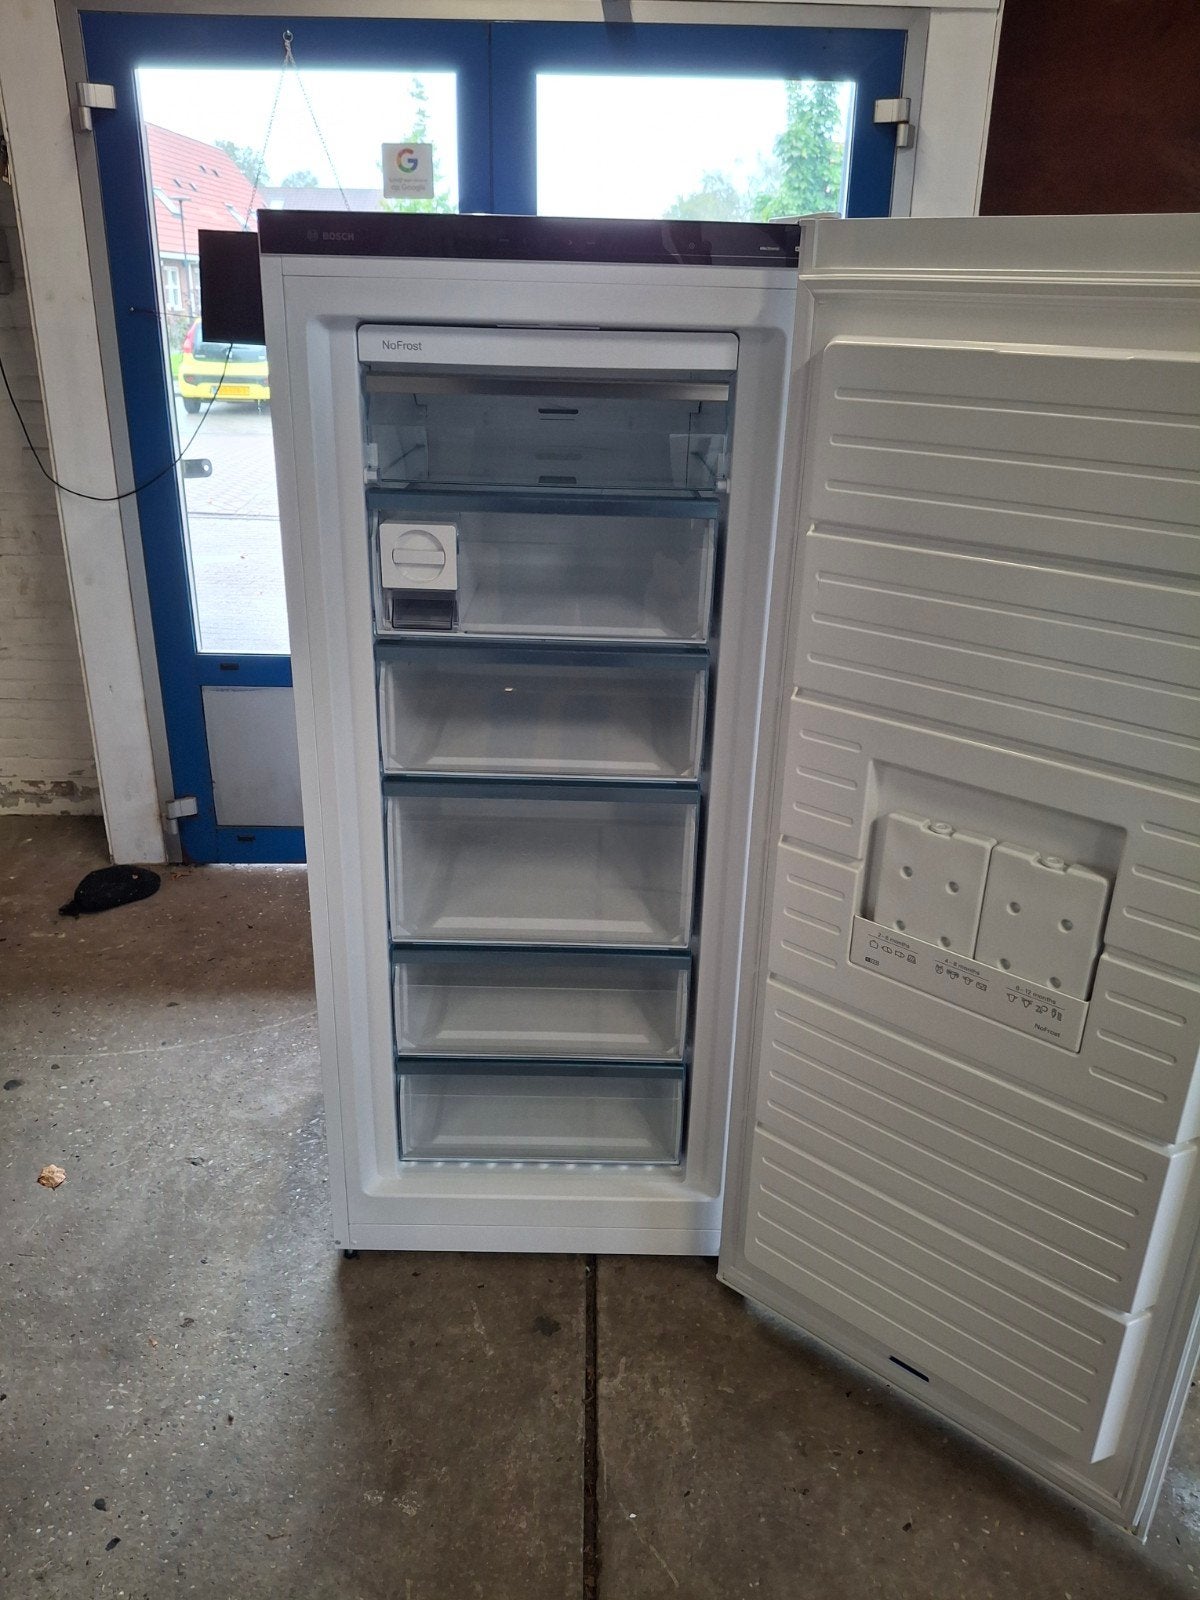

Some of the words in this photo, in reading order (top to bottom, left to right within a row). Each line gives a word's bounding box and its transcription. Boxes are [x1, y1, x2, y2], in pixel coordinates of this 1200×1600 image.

[396, 148, 418, 173] G
[322, 231, 355, 241] BOSCH
[382, 340, 422, 351] NoFrost
[1033, 992, 1056, 1004] months
[1034, 1023, 1061, 1038] NoFrost
